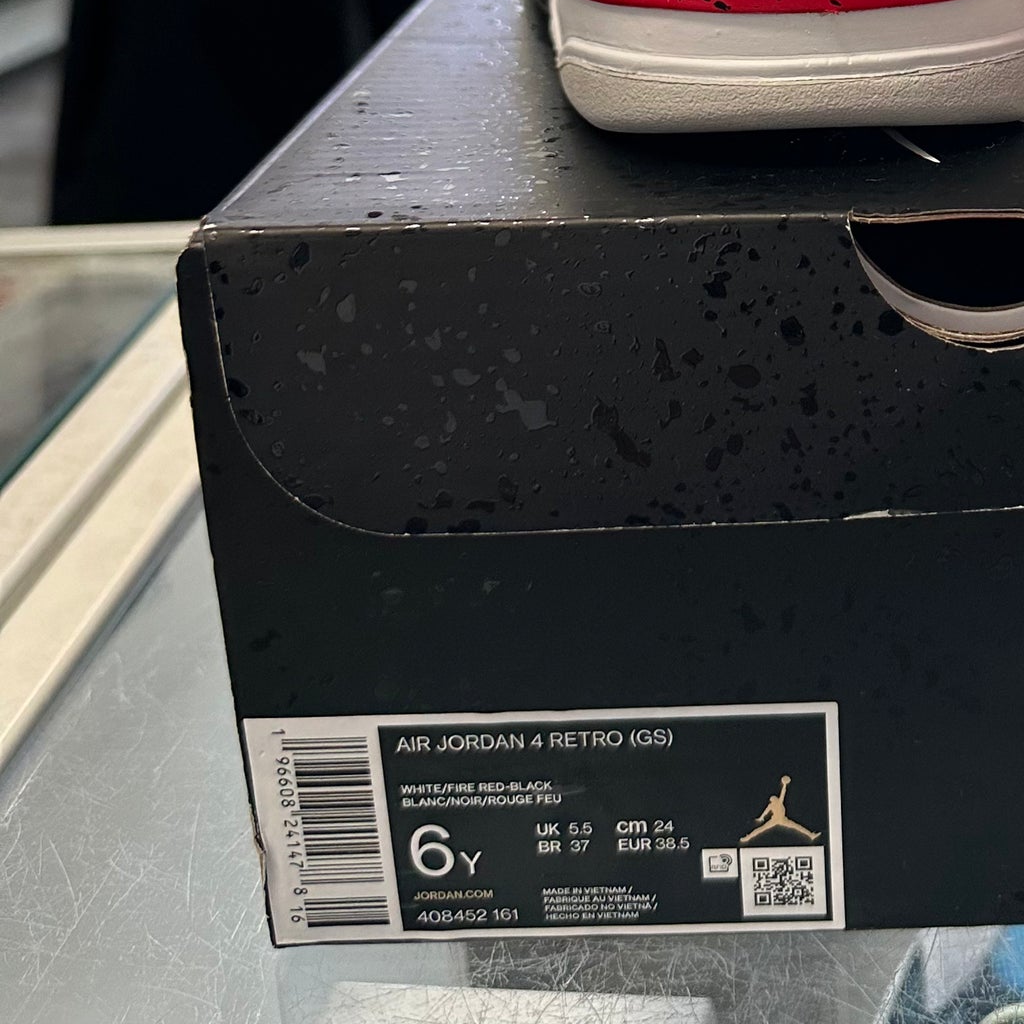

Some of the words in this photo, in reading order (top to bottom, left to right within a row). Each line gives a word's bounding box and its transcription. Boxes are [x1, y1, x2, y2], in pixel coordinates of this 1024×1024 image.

[395, 736, 431, 752] AIR
[436, 733, 525, 751] JORDAN
[530, 733, 544, 749] 4
[549, 730, 624, 748] RETRO
[629, 728, 674, 747] (GS)
[276, 756, 296, 809] 96608
[401, 783, 476, 795] WHITE/FIRE
[479, 780, 553, 793] RED-BLACK
[402, 794, 535, 808] BLANC/NOIR/ROUGE
[537, 793, 562, 805] FEU
[536, 822, 561, 836] UK
[568, 821, 593, 835] 5.5
[616, 820, 648, 833] cm
[654, 819, 675, 832] 24
[283, 818, 304, 869] 24147
[538, 839, 562, 853] BR
[570, 839, 590, 852] 37
[618, 837, 652, 851] EUR
[655, 836, 690, 850] 38.5
[293, 887, 308, 896] 8
[414, 889, 494, 901] JORDAN.COM
[542, 887, 570, 895] MADE
[583, 886, 626, 894] VIETNAM
[543, 895, 591, 904] FABRIQUE
[592, 895, 606, 903] AU
[607, 894, 650, 902] VIETNAM
[290, 905, 306, 924] 16
[417, 908, 488, 923] 408452
[492, 907, 519, 921] 161
[544, 904, 599, 912] FABRICADO
[600, 903, 615, 911] NO
[545, 912, 580, 920] HECHO
[597, 910, 640, 919] VIETNAM
